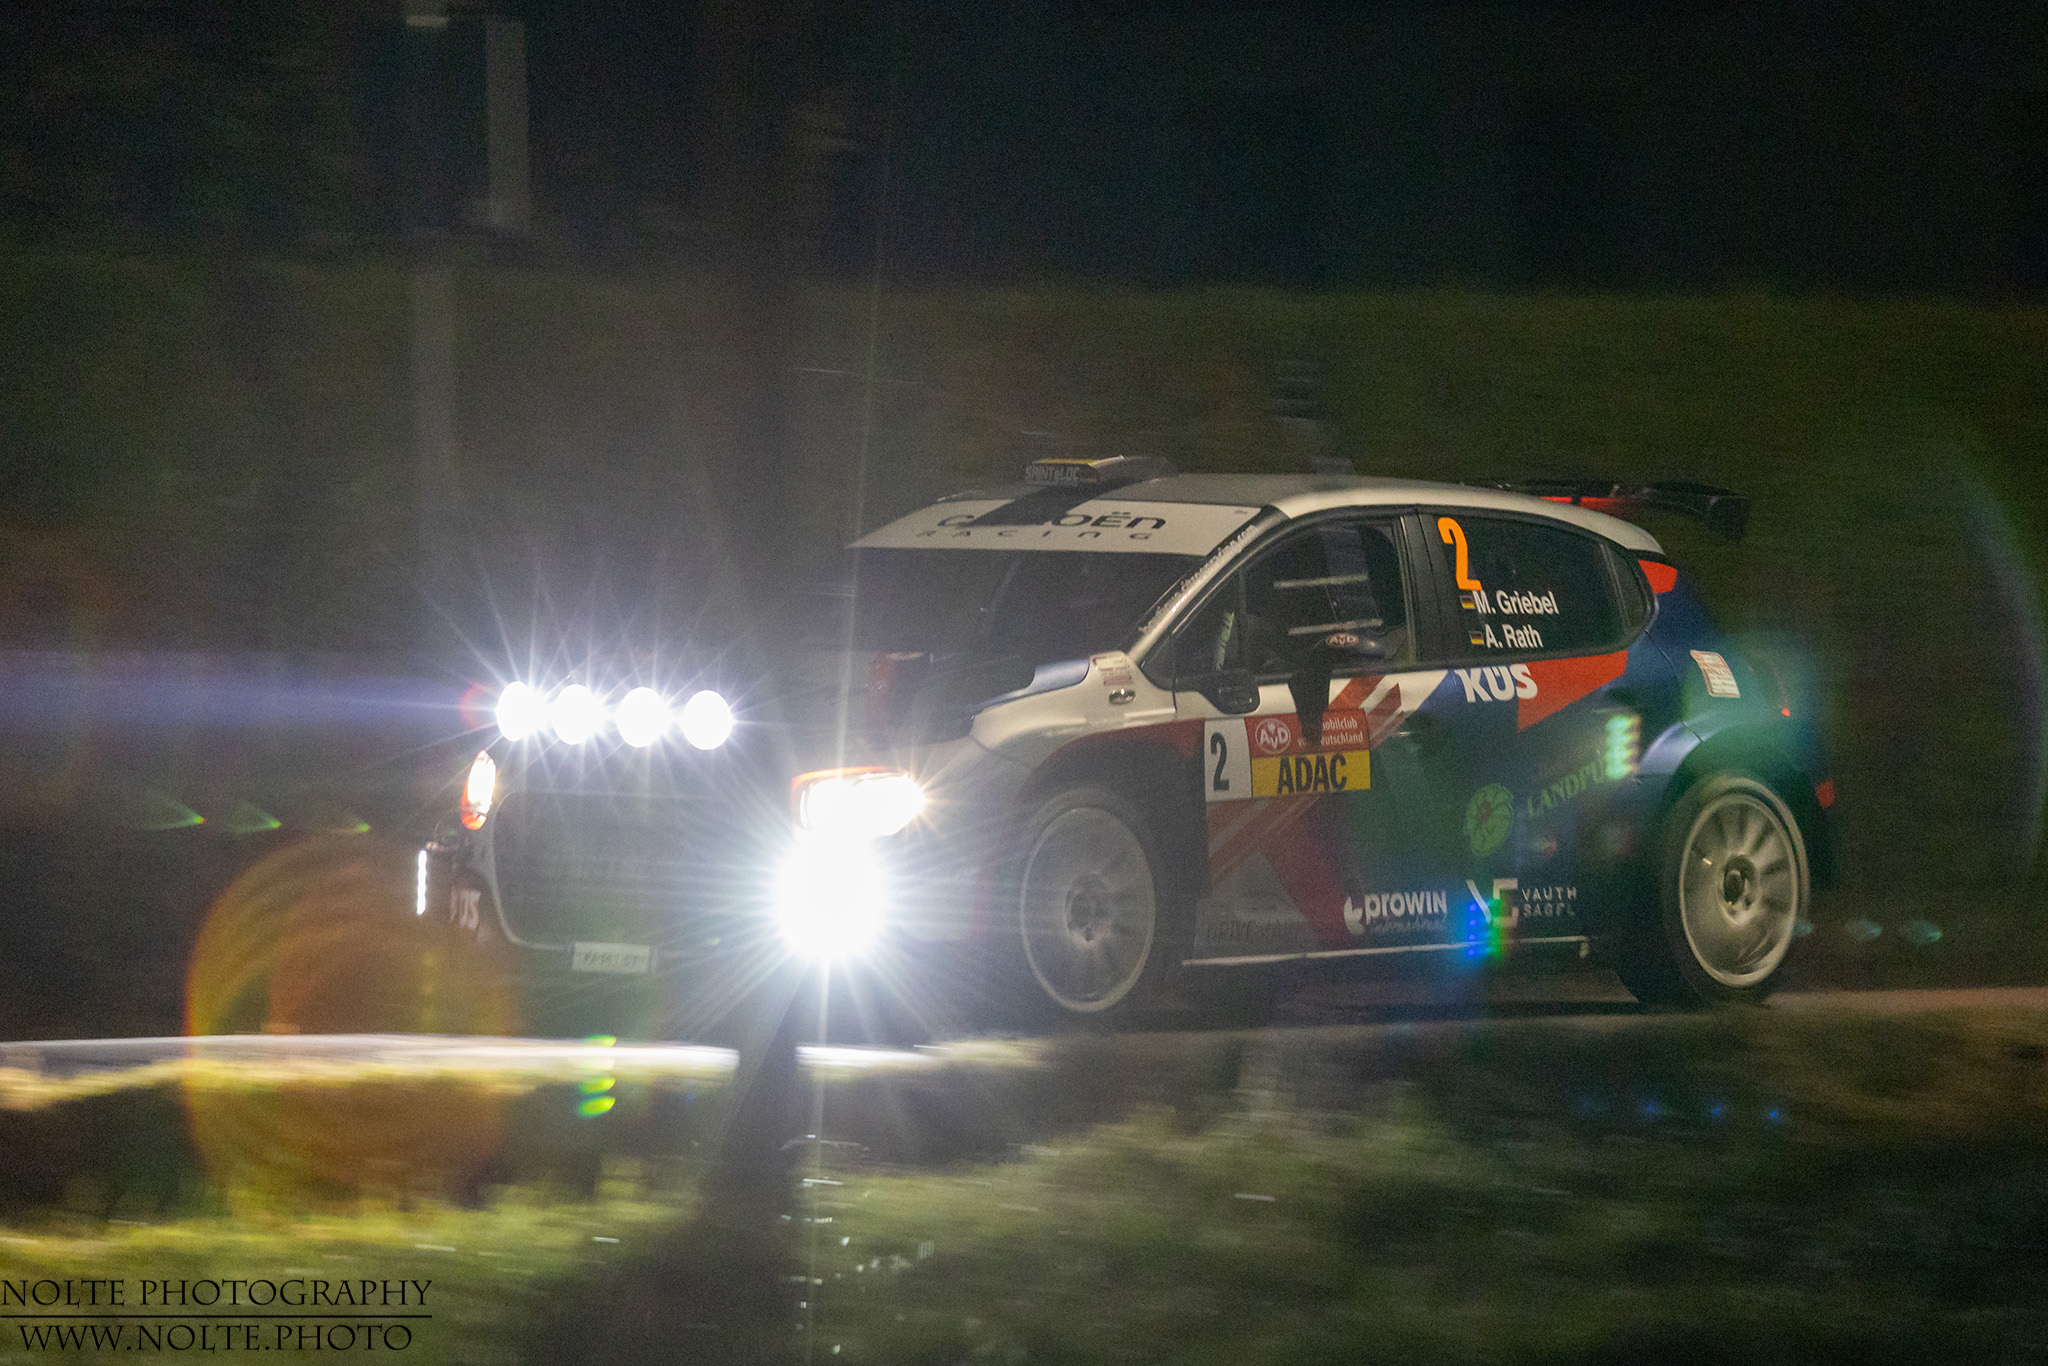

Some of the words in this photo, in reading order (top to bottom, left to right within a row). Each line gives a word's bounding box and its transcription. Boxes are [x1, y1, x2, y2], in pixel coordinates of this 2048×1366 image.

[1437, 517, 1483, 591] 2
[1474, 591, 1496, 614] M.
[1497, 590, 1560, 615] Griebel
[1485, 623, 1503, 648] A.
[1504, 623, 1544, 649] Rath
[1211, 732, 1230, 791] 2
[1277, 754, 1347, 794] ADAC
[1521, 886, 1577, 902] VAUTH
